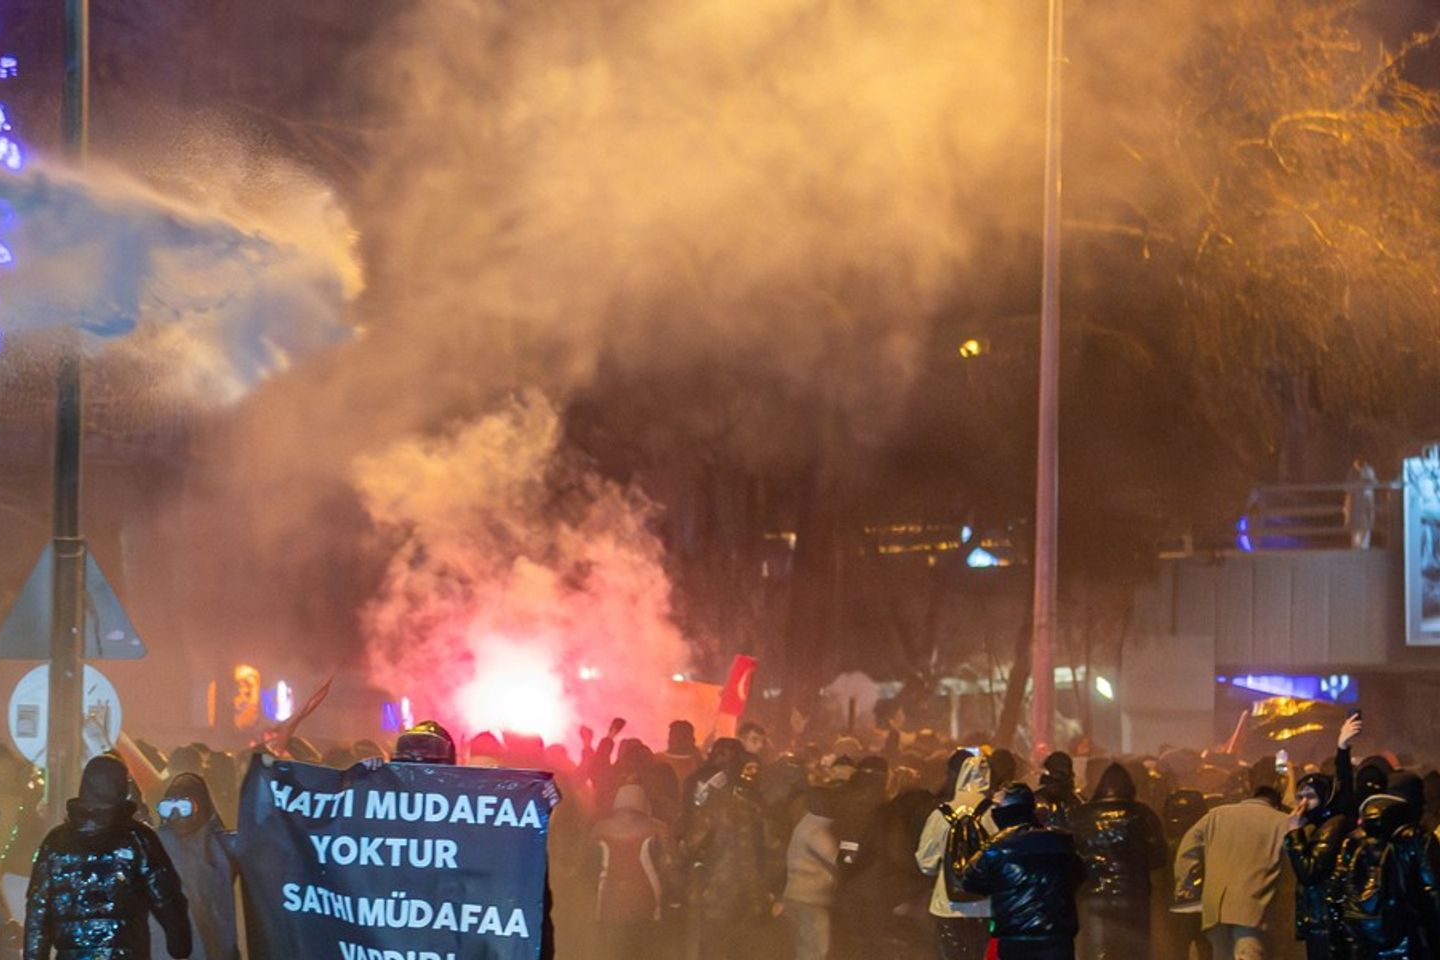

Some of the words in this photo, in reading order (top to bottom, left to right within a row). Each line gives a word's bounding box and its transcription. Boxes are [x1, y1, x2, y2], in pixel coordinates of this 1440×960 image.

[310, 834, 458, 868] YOKTUR
[282, 882, 355, 924] SATHI
[358, 891, 530, 938] MÜDAFAA
